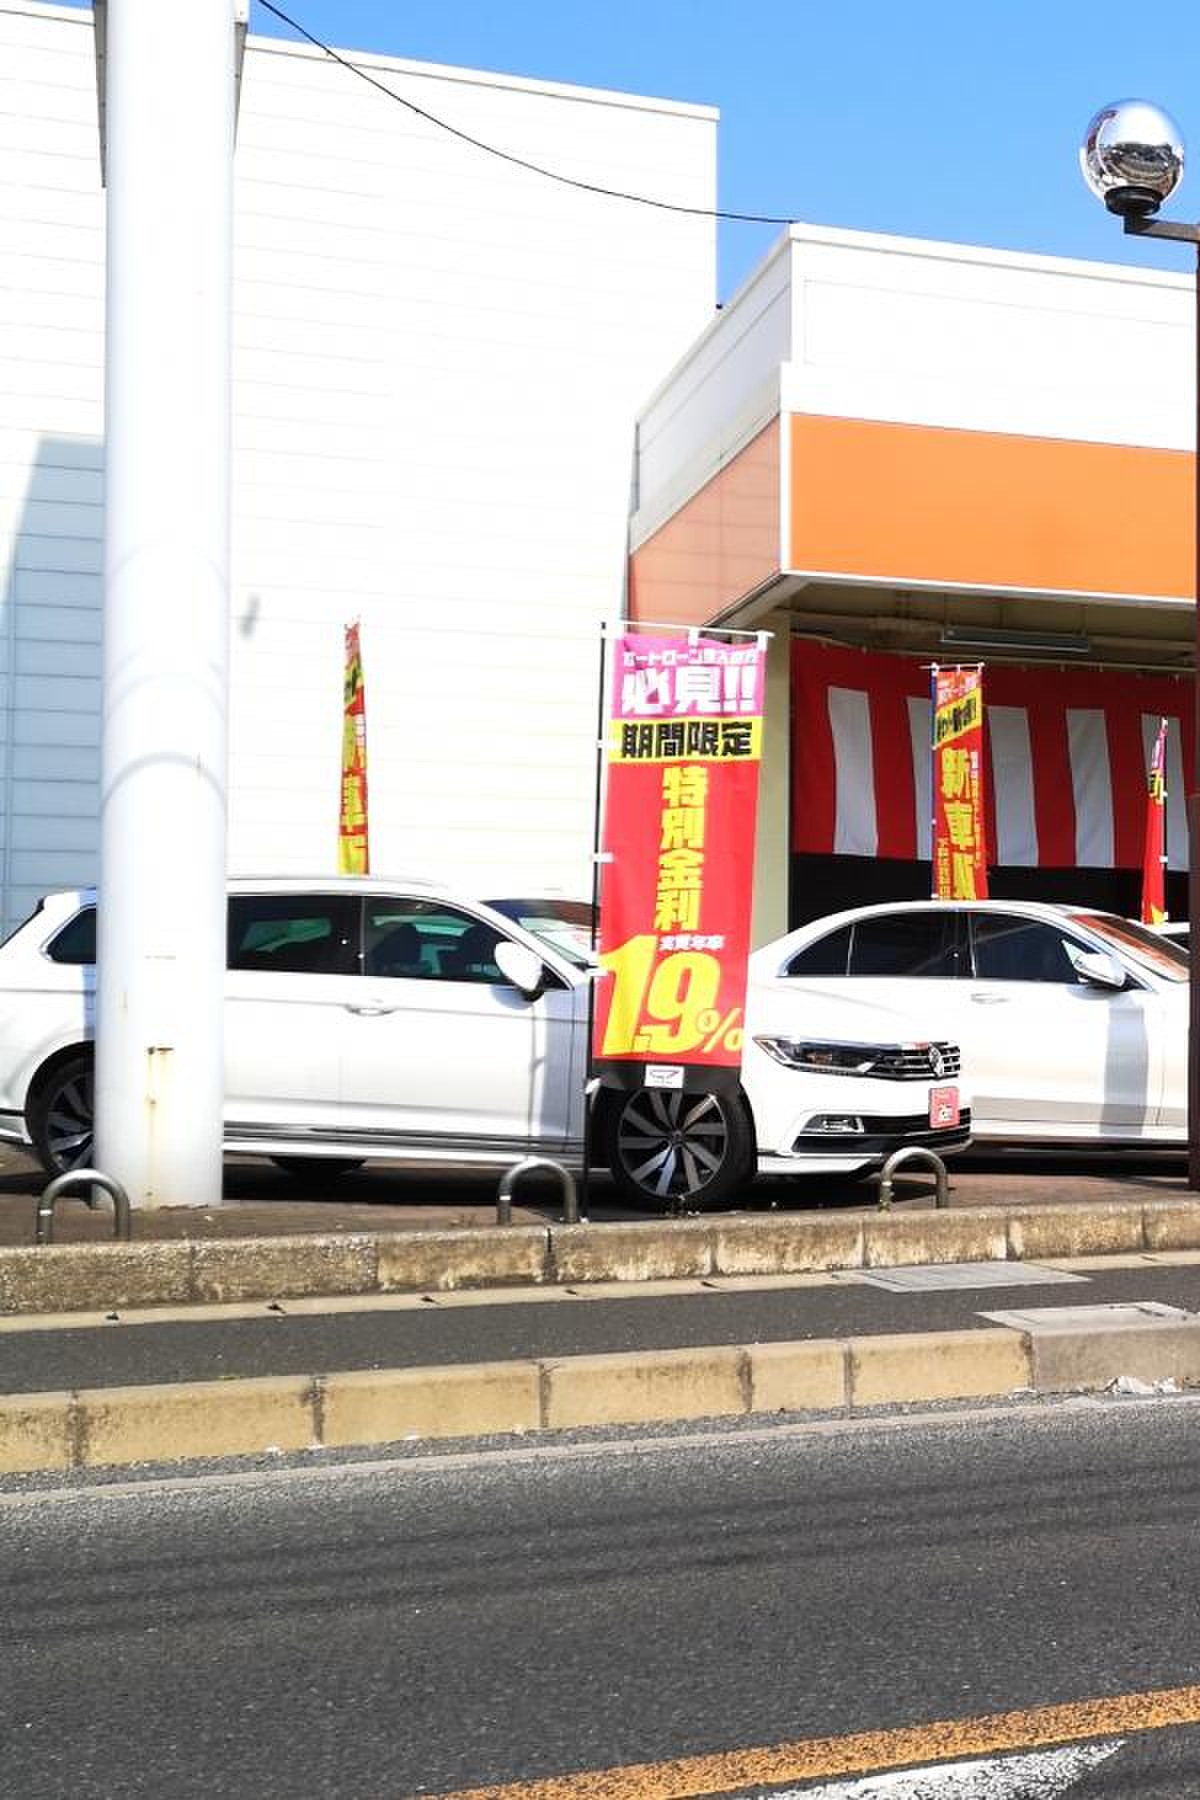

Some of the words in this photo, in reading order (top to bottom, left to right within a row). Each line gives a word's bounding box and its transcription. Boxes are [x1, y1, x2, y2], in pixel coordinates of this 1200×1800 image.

[622, 721, 752, 758] 期間限定
[653, 765, 708, 931] 特別金利
